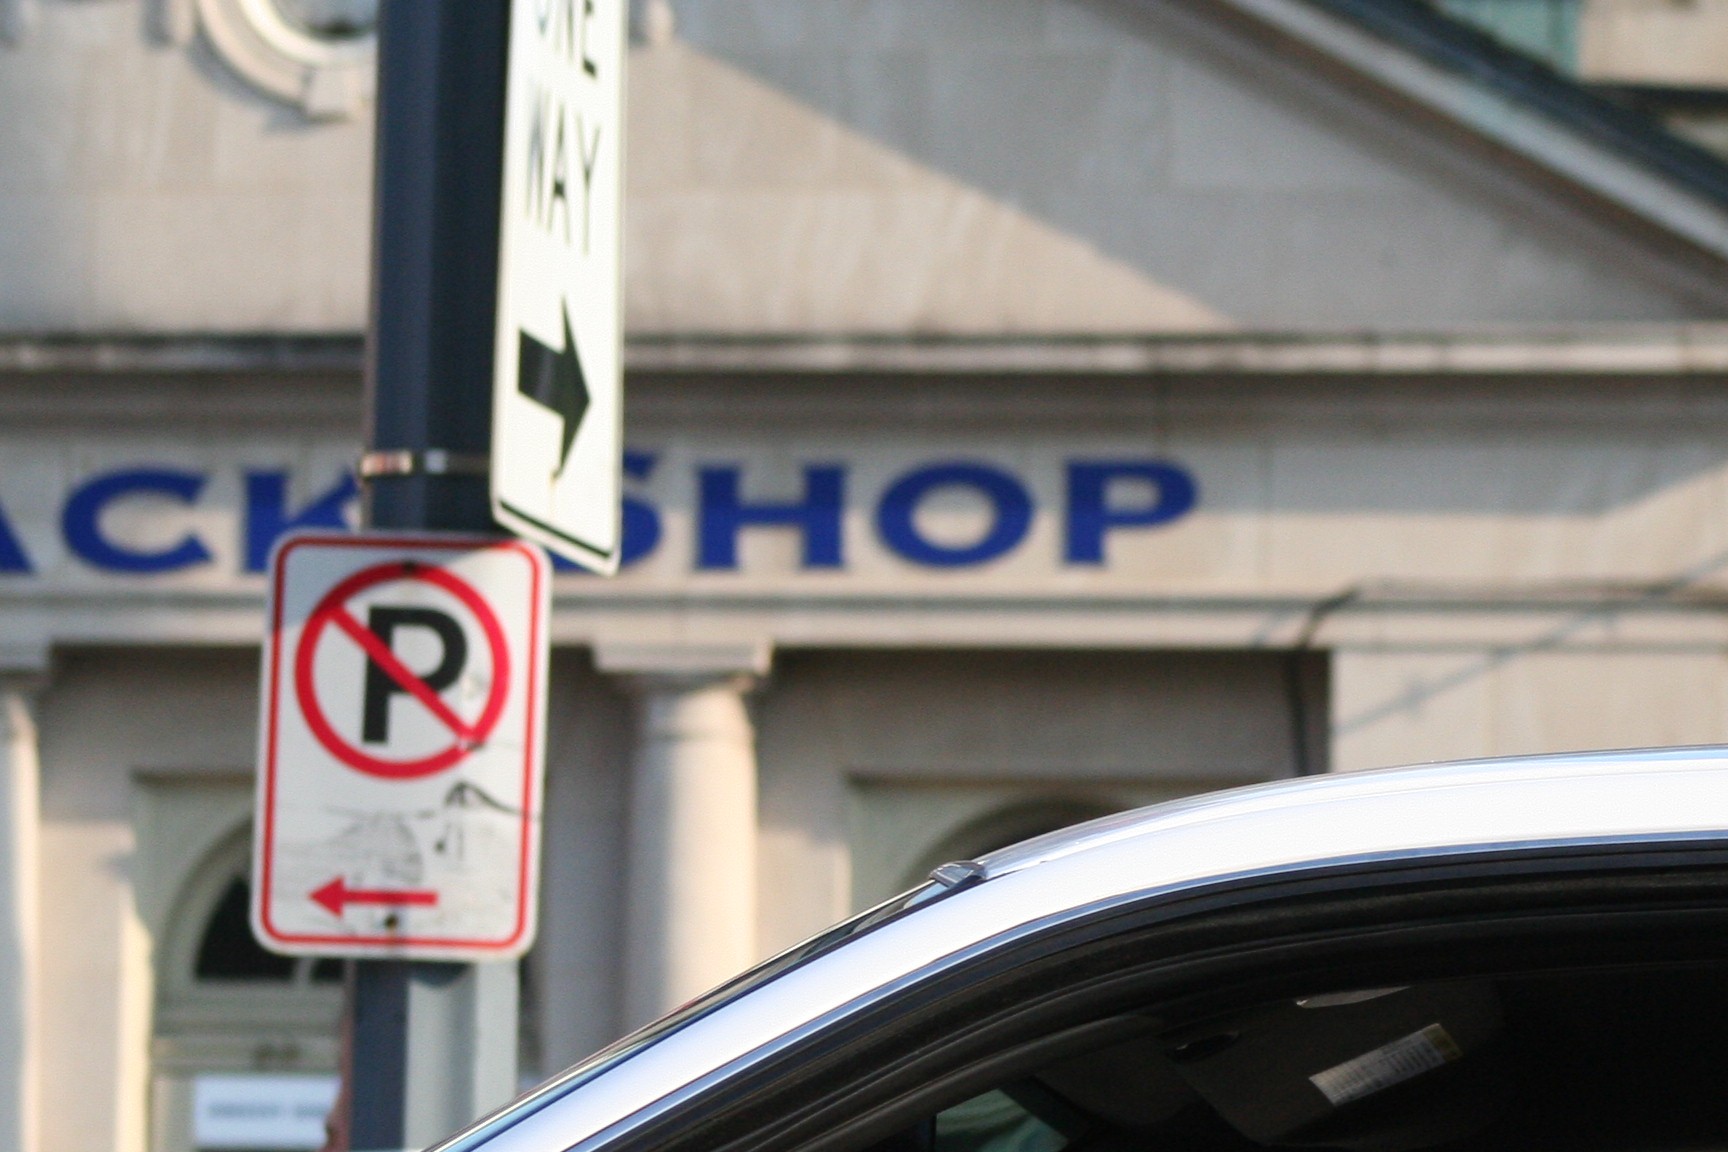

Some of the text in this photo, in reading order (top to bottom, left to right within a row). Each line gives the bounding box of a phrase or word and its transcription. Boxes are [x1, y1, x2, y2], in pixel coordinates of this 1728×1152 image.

[525, 80, 601, 256] WAY
[0, 466, 359, 574] CK
[362, 605, 468, 745] P
